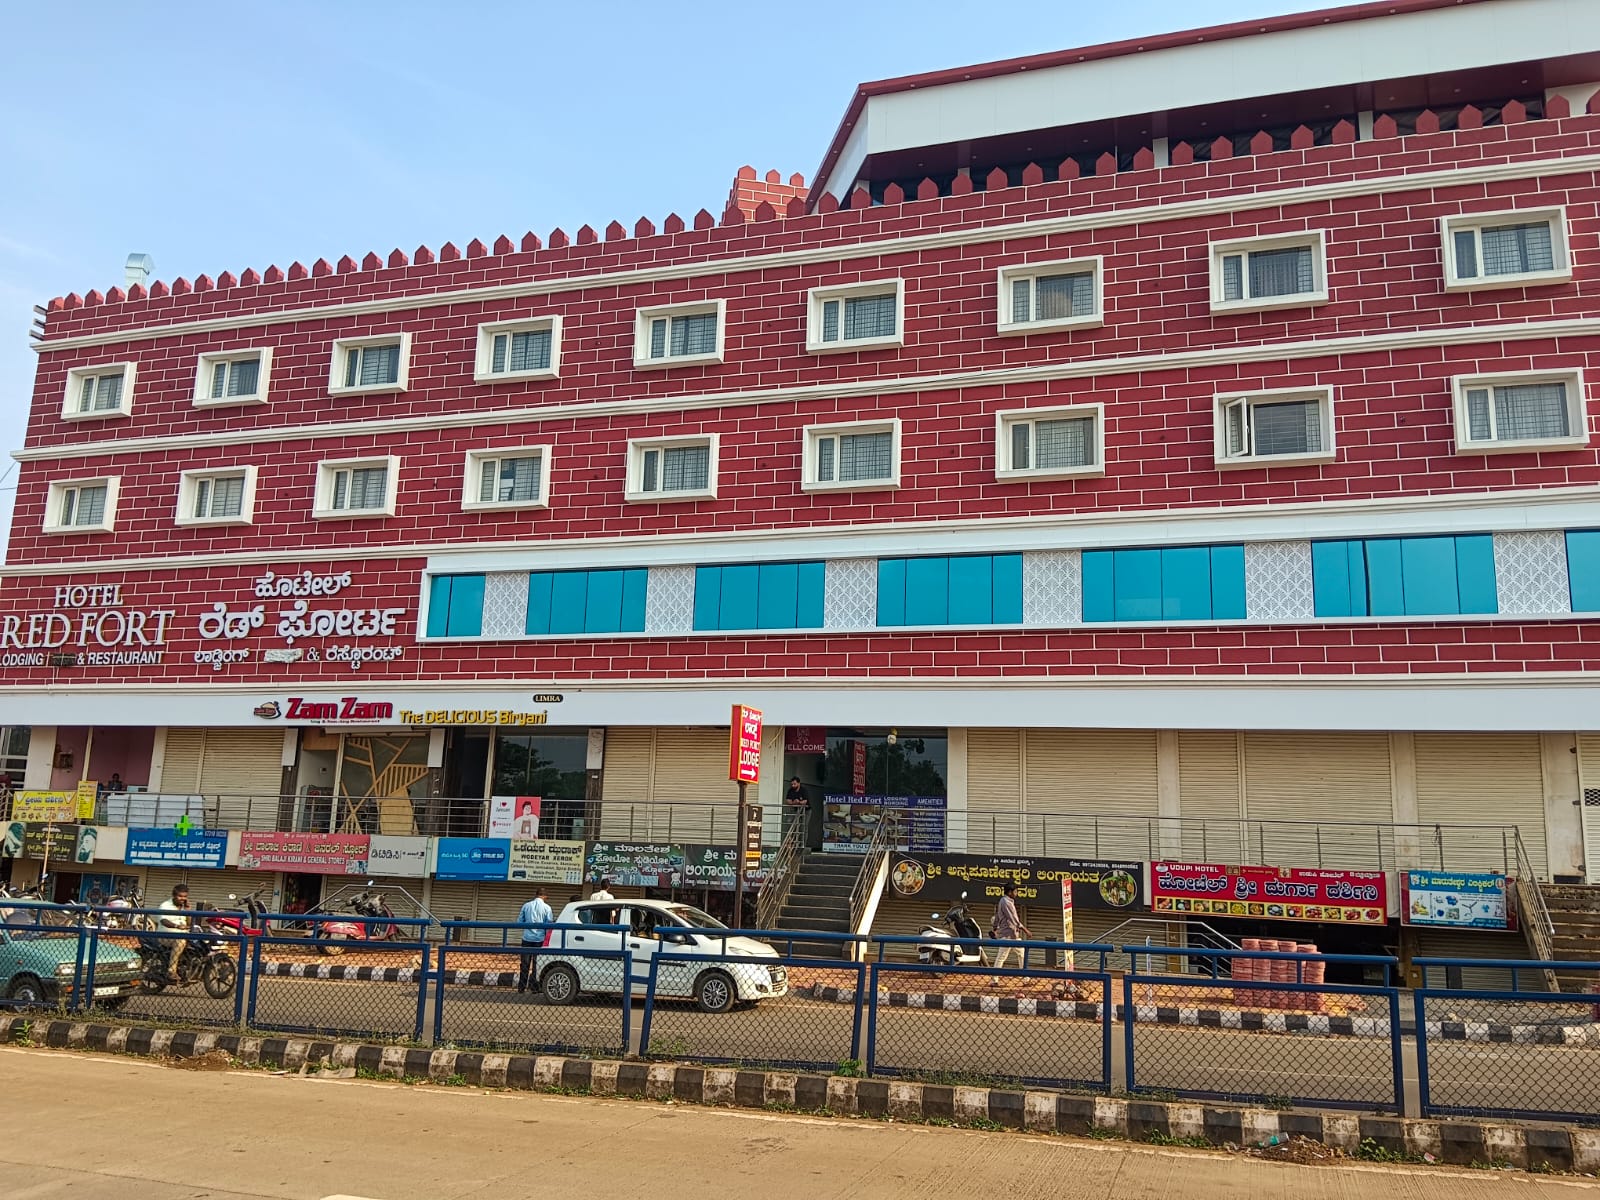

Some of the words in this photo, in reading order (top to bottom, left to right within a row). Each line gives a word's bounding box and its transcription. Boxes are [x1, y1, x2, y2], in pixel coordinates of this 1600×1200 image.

[53, 585, 124, 608] HOTEL
[198, 602, 265, 639] ರೆಡ್
[0, 613, 71, 649] RED
[77, 610, 176, 648] FORT
[0, 653, 44, 666] ODGING
[77, 653, 85, 665] &
[88, 651, 165, 665] RESTAURANT
[307, 646, 321, 662] &
[285, 697, 339, 720] Zam
[340, 697, 393, 720] Zam
[400, 710, 424, 724] The
[425, 710, 498, 725] DELICIOUS
[499, 710, 548, 727] Biryani
[740, 750, 760, 767] LODGE
[848, 796, 863, 804] Red
[272, 855, 287, 863] BALAJI
[308, 856, 328, 864] GENERAL
[328, 857, 345, 865] STORES
[704, 849, 719, 863] ಶ್ರೀ
[926, 863, 942, 879] ಶ್ರೀ
[1170, 864, 1193, 872] UDUPI
[1195, 865, 1220, 873] HOTEL
[1234, 876, 1258, 900] ಶ್ರೀ
[1264, 877, 1318, 899] ದುರ್ಗಾ
[1326, 880, 1378, 902] ದರ್ಶಿನಿ
